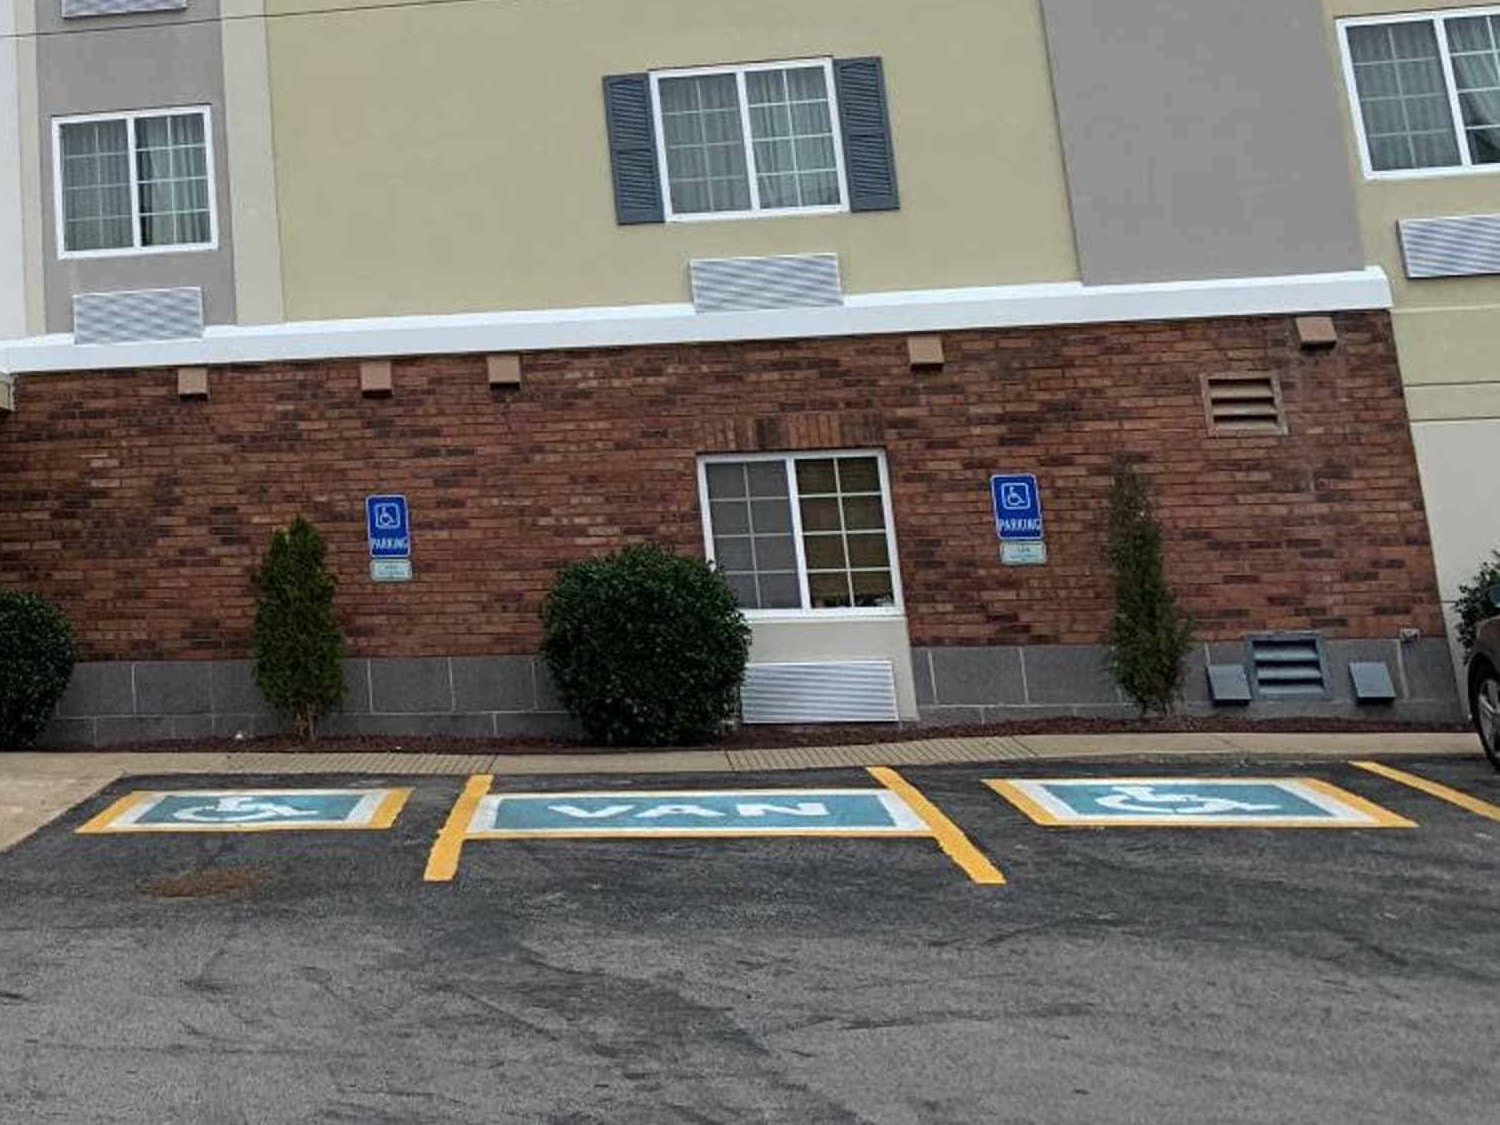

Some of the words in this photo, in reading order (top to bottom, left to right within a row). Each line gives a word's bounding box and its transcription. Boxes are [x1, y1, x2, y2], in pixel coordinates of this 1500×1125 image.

[998, 518, 1042, 531] PARKING
[368, 537, 409, 549] PARKING
[547, 802, 830, 818] VAN
